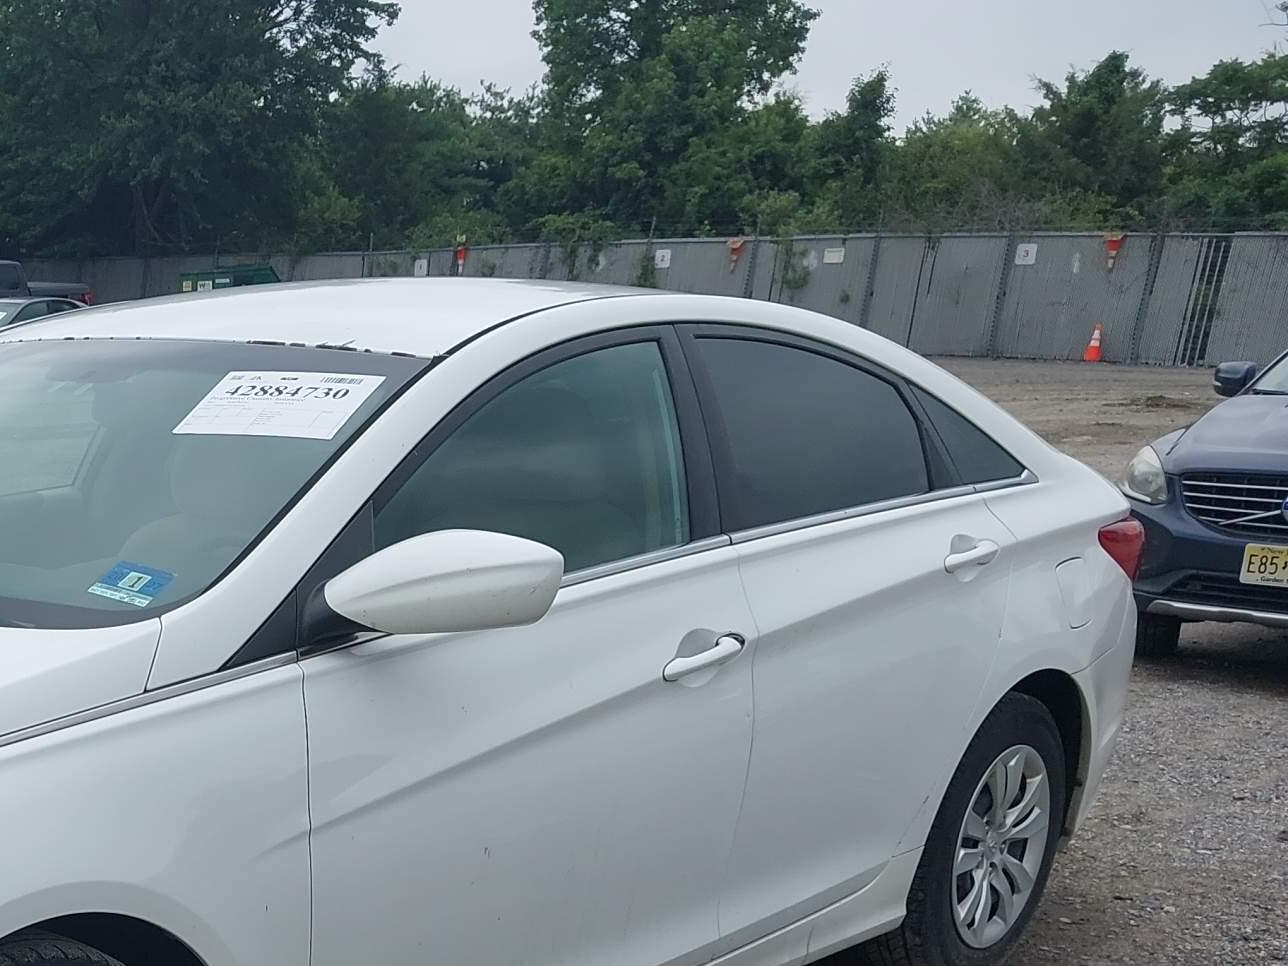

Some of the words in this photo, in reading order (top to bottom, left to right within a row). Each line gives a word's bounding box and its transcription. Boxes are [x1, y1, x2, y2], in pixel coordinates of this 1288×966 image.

[225, 384, 350, 400] 42884730
[1247, 554, 1280, 575] E85
[127, 576, 144, 588] 1
